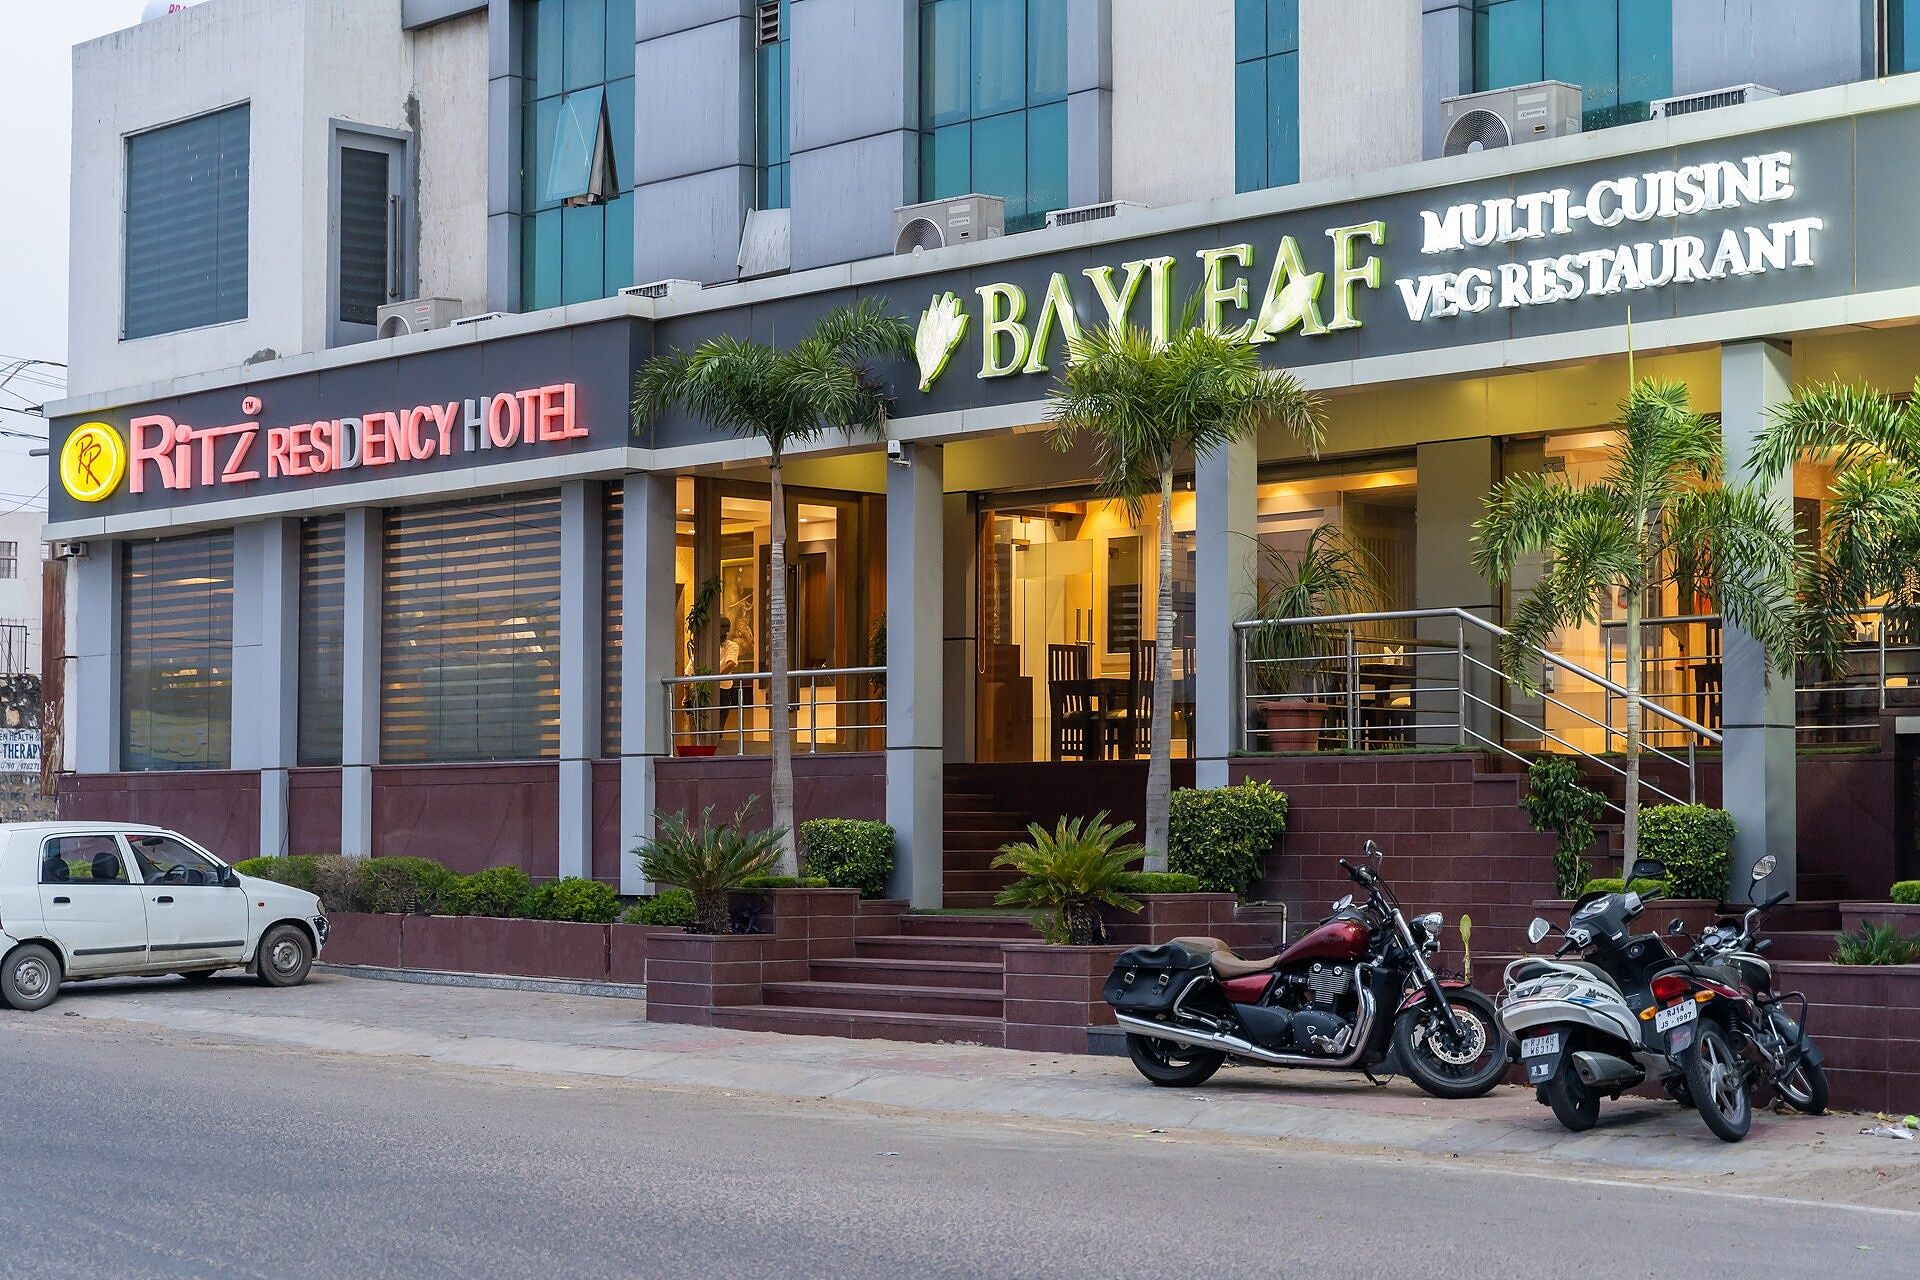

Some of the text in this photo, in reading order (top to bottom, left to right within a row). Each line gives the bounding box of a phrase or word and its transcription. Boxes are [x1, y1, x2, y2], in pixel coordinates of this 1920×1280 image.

[1420, 152, 1794, 255] MULTI-CUISINE
[975, 220, 1386, 380] BAYLEAF
[1395, 217, 1824, 322] VEG RESTAURANT
[267, 402, 460, 479] RESIDENCY
[464, 383, 589, 452] HOTEL
[1666, 1005, 1684, 1018] RJ14
[1676, 1011, 1692, 1023] 1997
